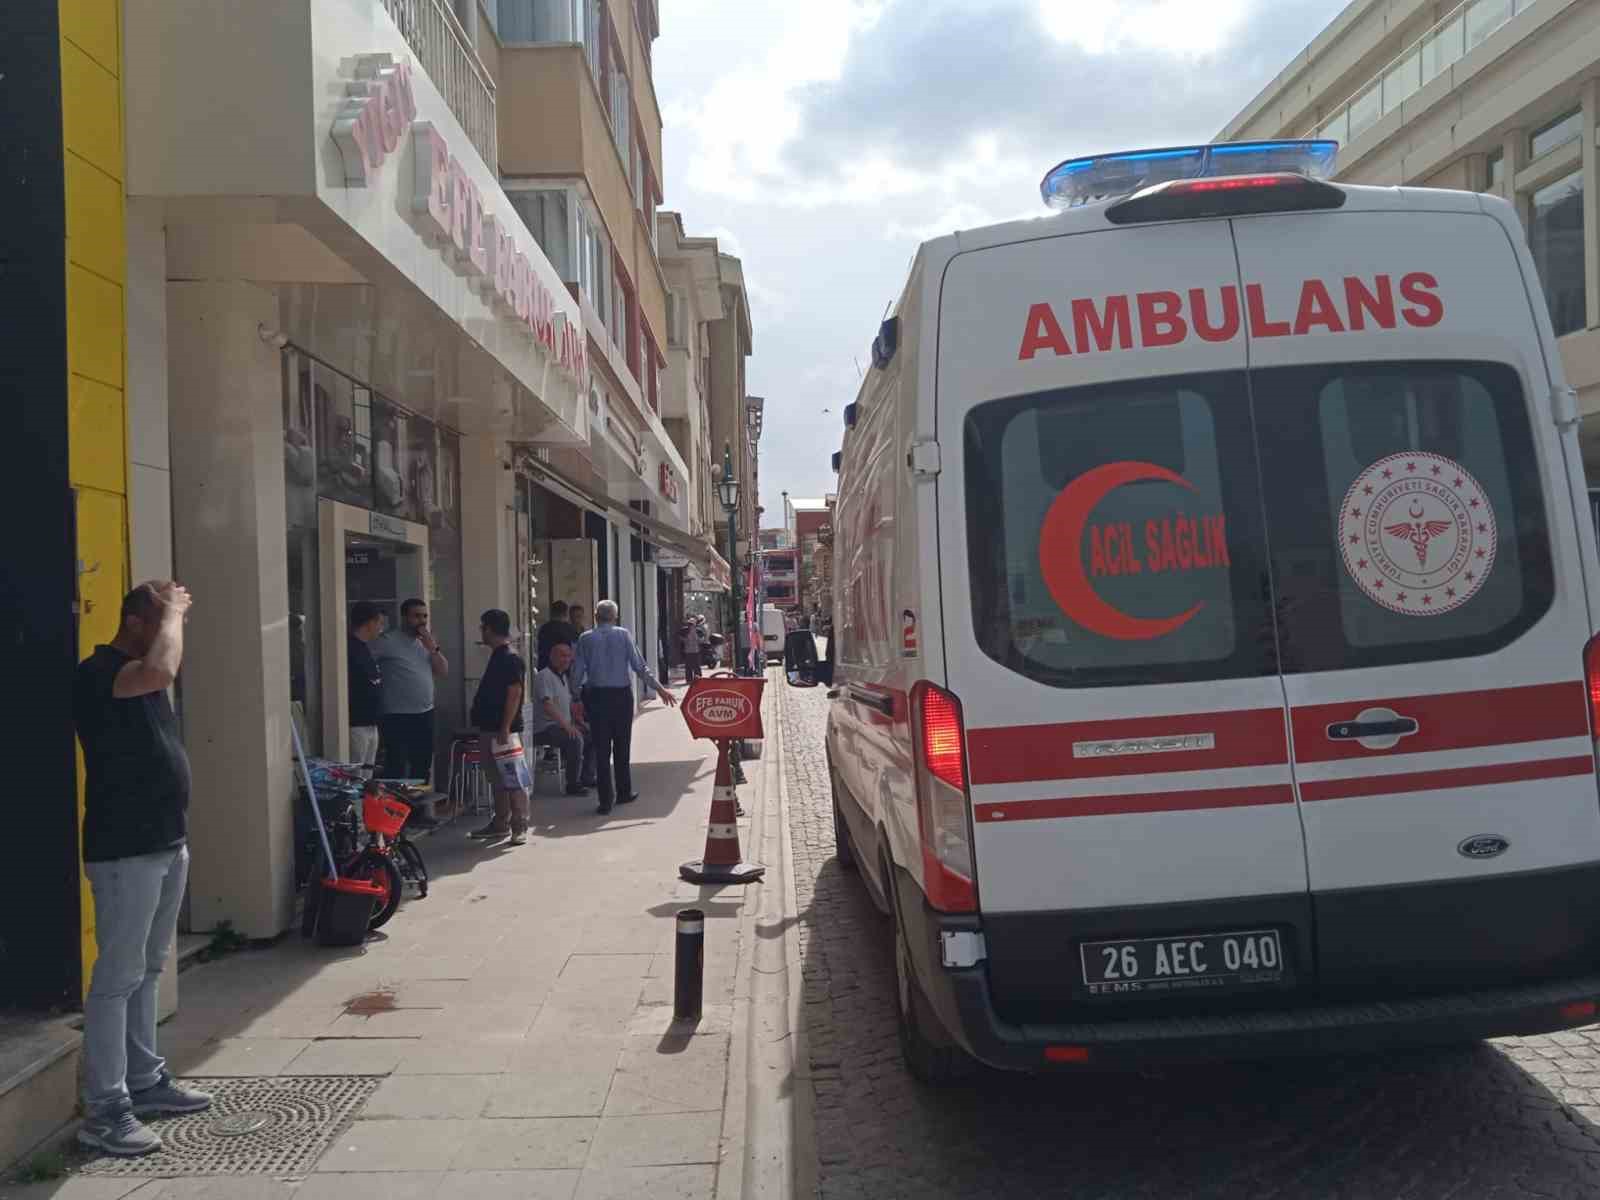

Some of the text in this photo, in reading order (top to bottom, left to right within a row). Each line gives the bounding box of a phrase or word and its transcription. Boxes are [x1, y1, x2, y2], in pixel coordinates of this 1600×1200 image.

[1018, 272, 1444, 360] AMBULANS
[1090, 511, 1232, 577] ACİL SAĞLIK
[708, 709, 733, 719] AVM
[1102, 936, 1277, 979] 26 AEC 040
